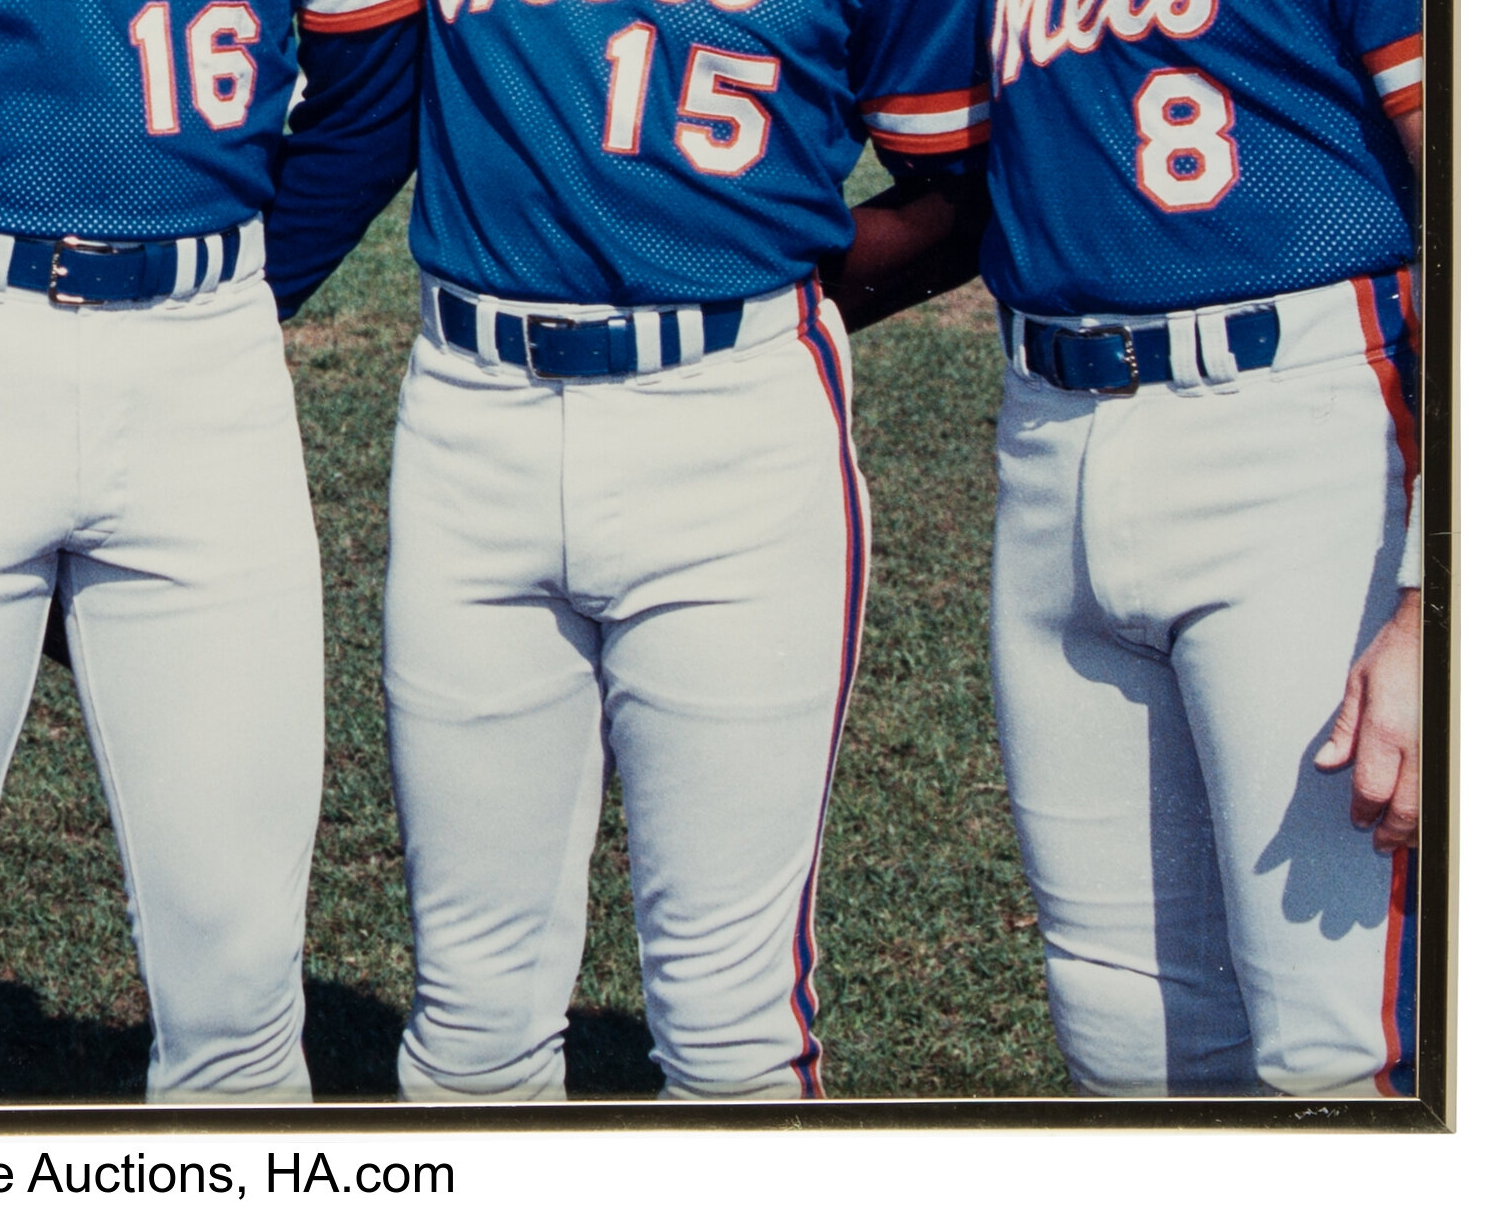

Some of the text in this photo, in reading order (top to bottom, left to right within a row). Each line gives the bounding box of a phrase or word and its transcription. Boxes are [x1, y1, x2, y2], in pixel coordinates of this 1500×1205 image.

[129, 0, 261, 135] 16
[602, 20, 781, 178] 15
[1134, 66, 1239, 213] 8
